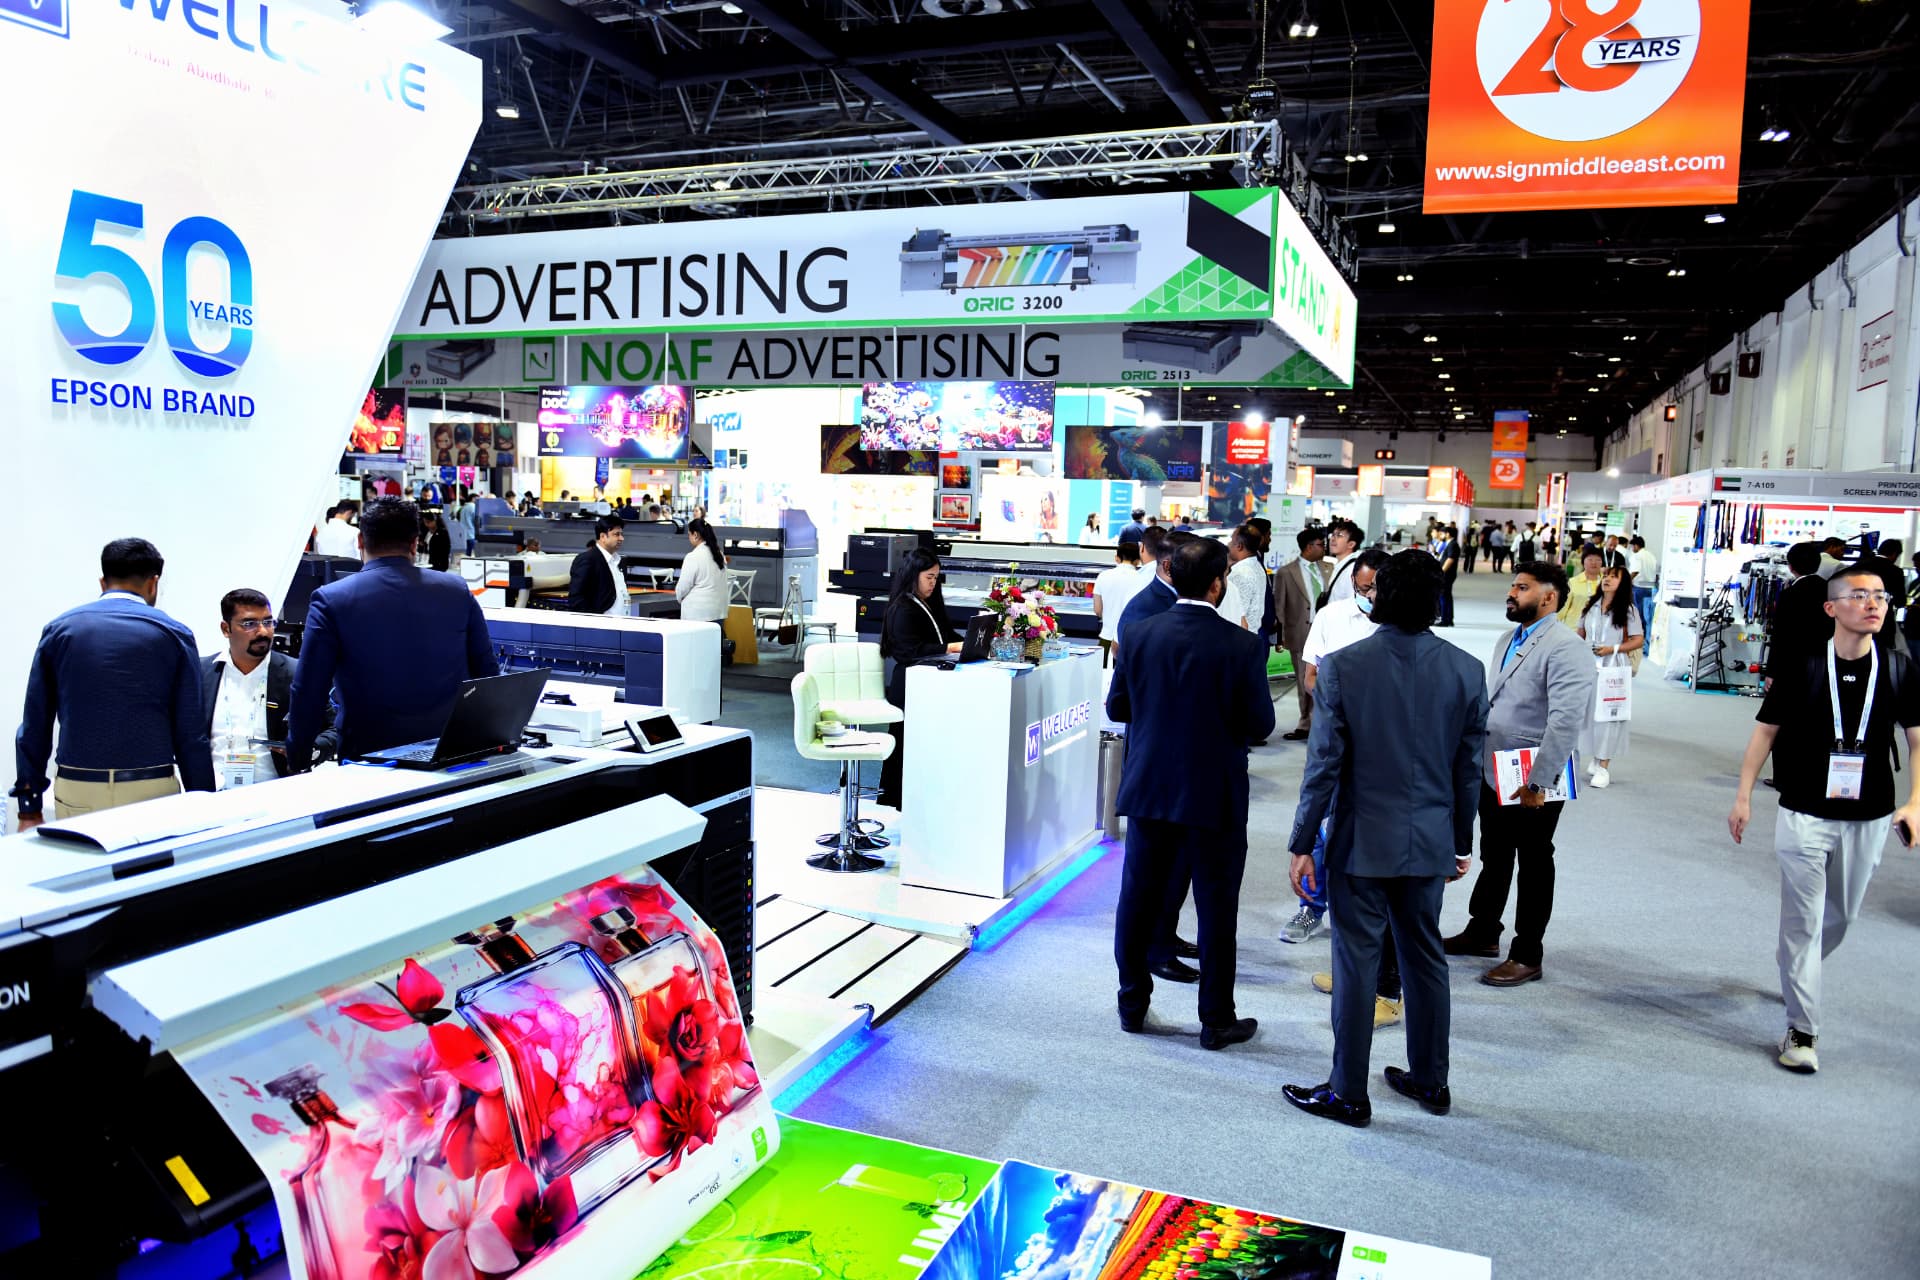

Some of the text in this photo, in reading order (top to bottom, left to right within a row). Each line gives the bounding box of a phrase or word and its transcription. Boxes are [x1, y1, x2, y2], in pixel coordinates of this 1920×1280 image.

[1599, 38, 1682, 61] YEARS
[1435, 155, 1727, 183] www.signmiddleeast.com
[51, 189, 253, 377] 50
[420, 246, 848, 327] ADVERTISING
[189, 299, 253, 327] YEARS
[964, 295, 1063, 313] ORIC 3200
[581, 339, 712, 382] NOAF
[727, 331, 1060, 381] ADVERTISING
[1121, 370, 1191, 381] ORIC 2513
[51, 377, 256, 419] EPSON BRAND
[1843, 488, 1918, 498] SCREEN PRINTING
